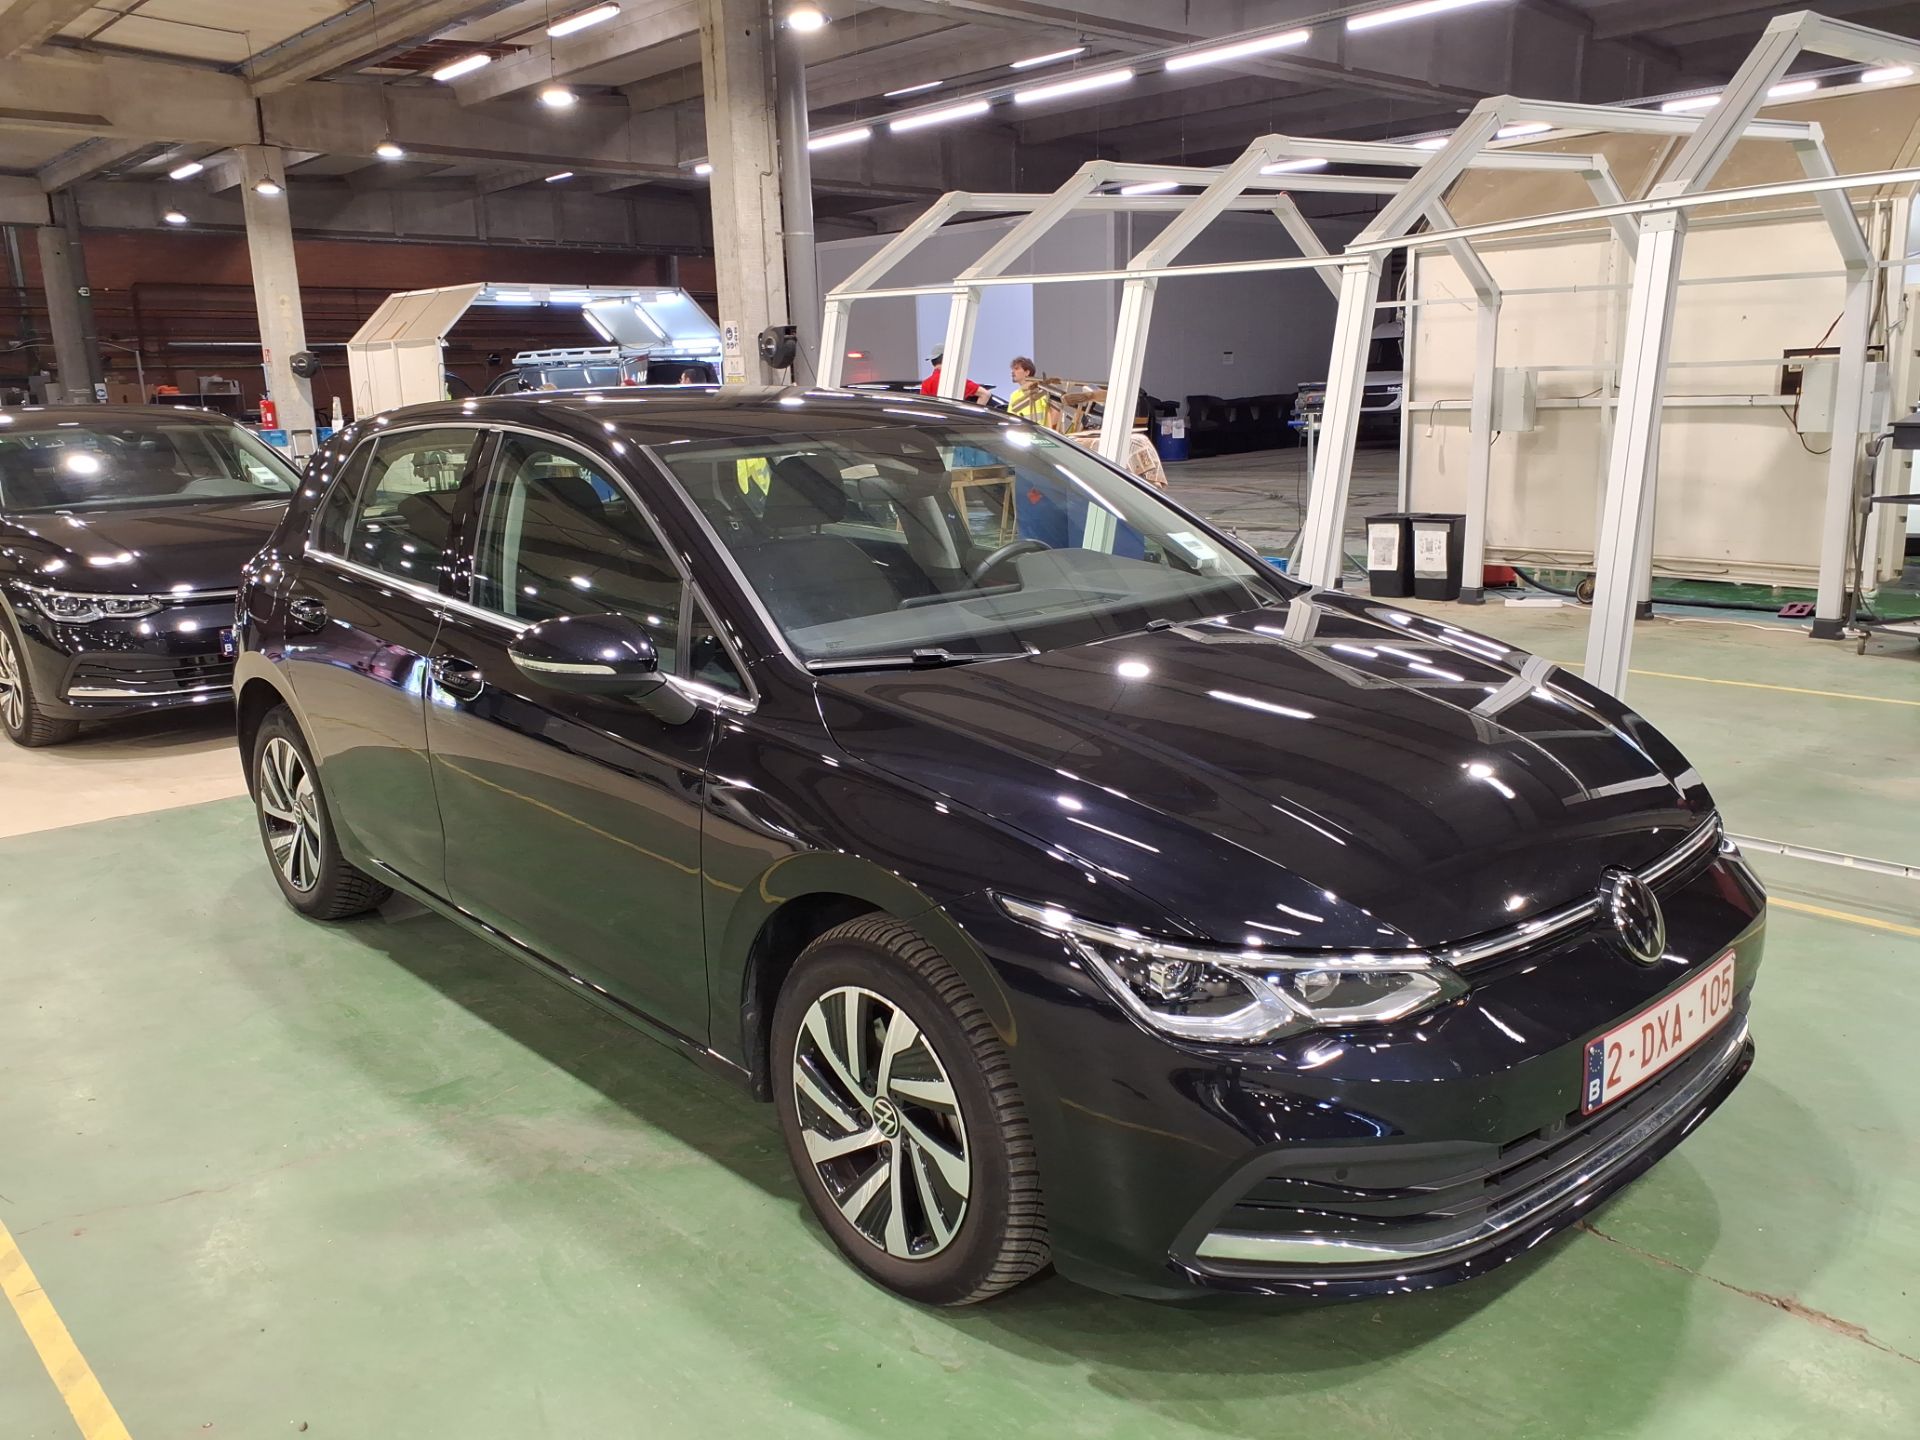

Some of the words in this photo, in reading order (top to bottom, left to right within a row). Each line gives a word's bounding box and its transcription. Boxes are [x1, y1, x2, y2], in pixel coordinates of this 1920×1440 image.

[224, 643, 233, 652] B
[1588, 1078, 1600, 1102] B
[1607, 964, 1732, 1089] 2-DXA-105
